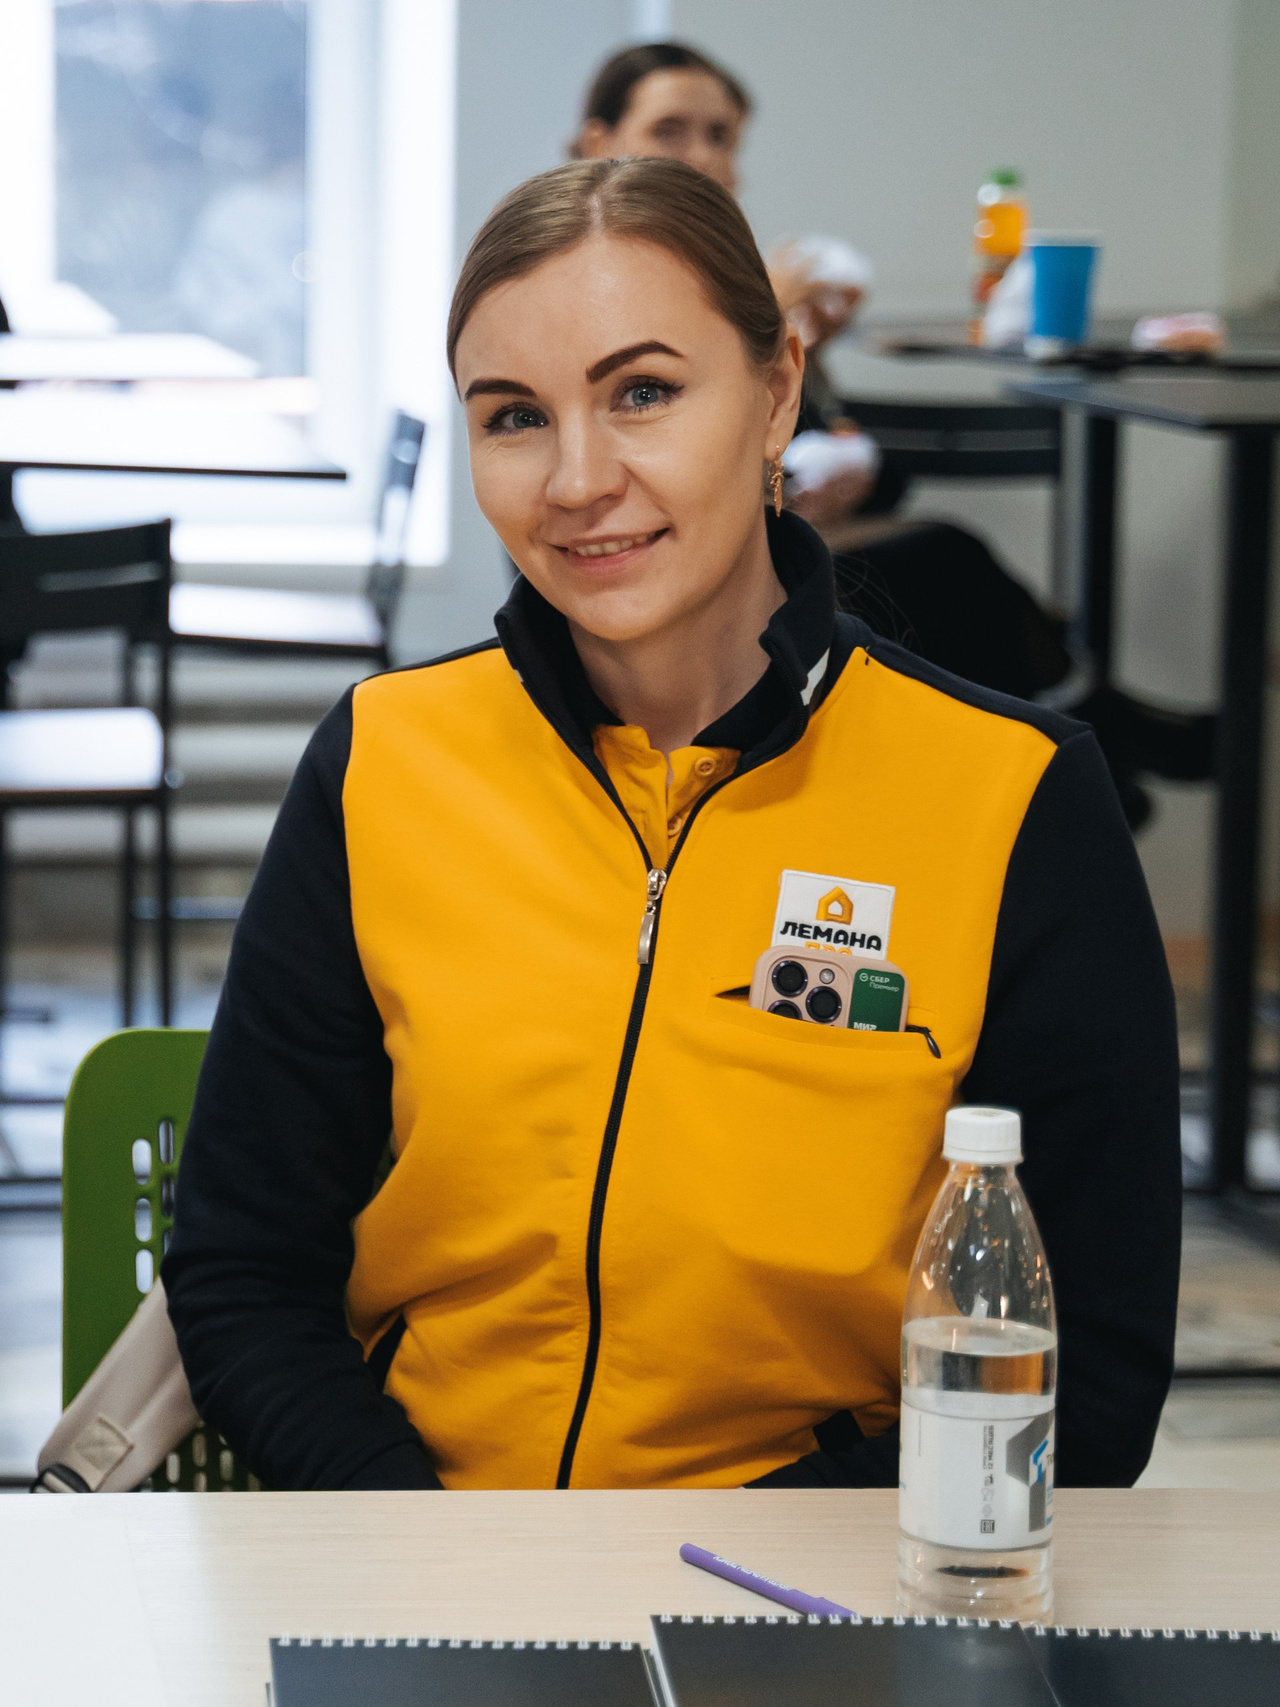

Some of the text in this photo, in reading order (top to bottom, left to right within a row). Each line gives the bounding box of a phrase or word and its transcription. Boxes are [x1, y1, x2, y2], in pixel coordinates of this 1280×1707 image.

[780, 921, 882, 951] ЛЕМАНА
[869, 975, 890, 984] СБЕР
[853, 1021, 877, 1031] МИР
